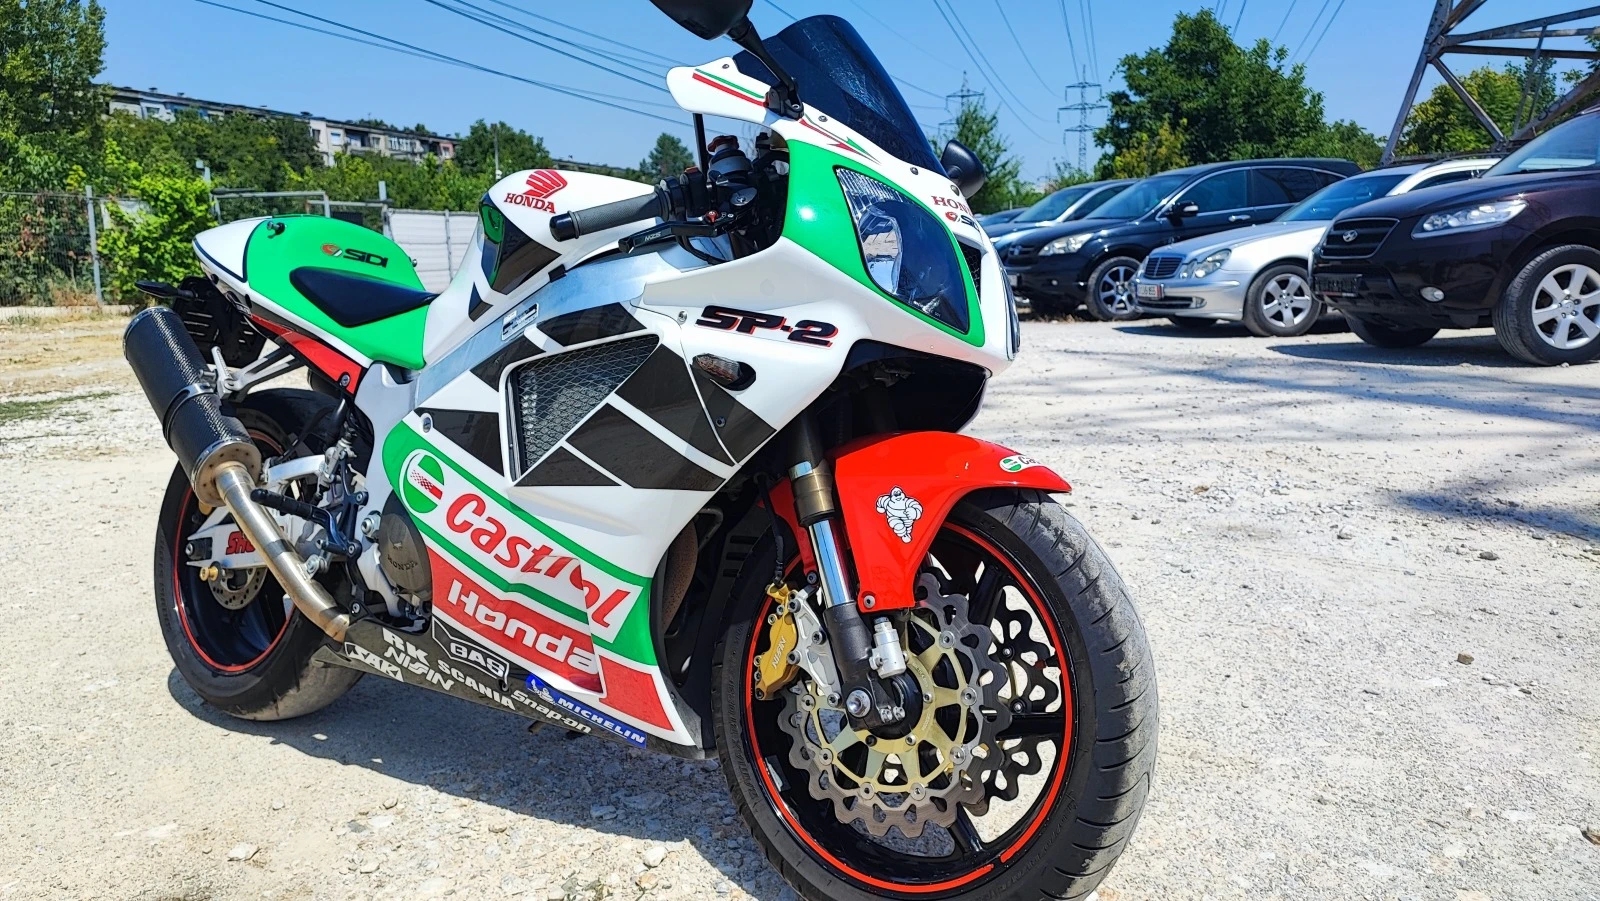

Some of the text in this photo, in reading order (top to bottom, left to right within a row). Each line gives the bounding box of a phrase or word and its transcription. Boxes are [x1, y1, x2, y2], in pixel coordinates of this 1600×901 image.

[503, 192, 556, 214] HONDA
[695, 305, 839, 348] SP-2
[445, 493, 631, 628] Castrol
[382, 627, 431, 667] RK
[447, 578, 600, 675] Honda
[437, 659, 516, 711] SCANIA
[510, 689, 592, 735] Snap-on
[557, 696, 646, 744] MICHELIN
